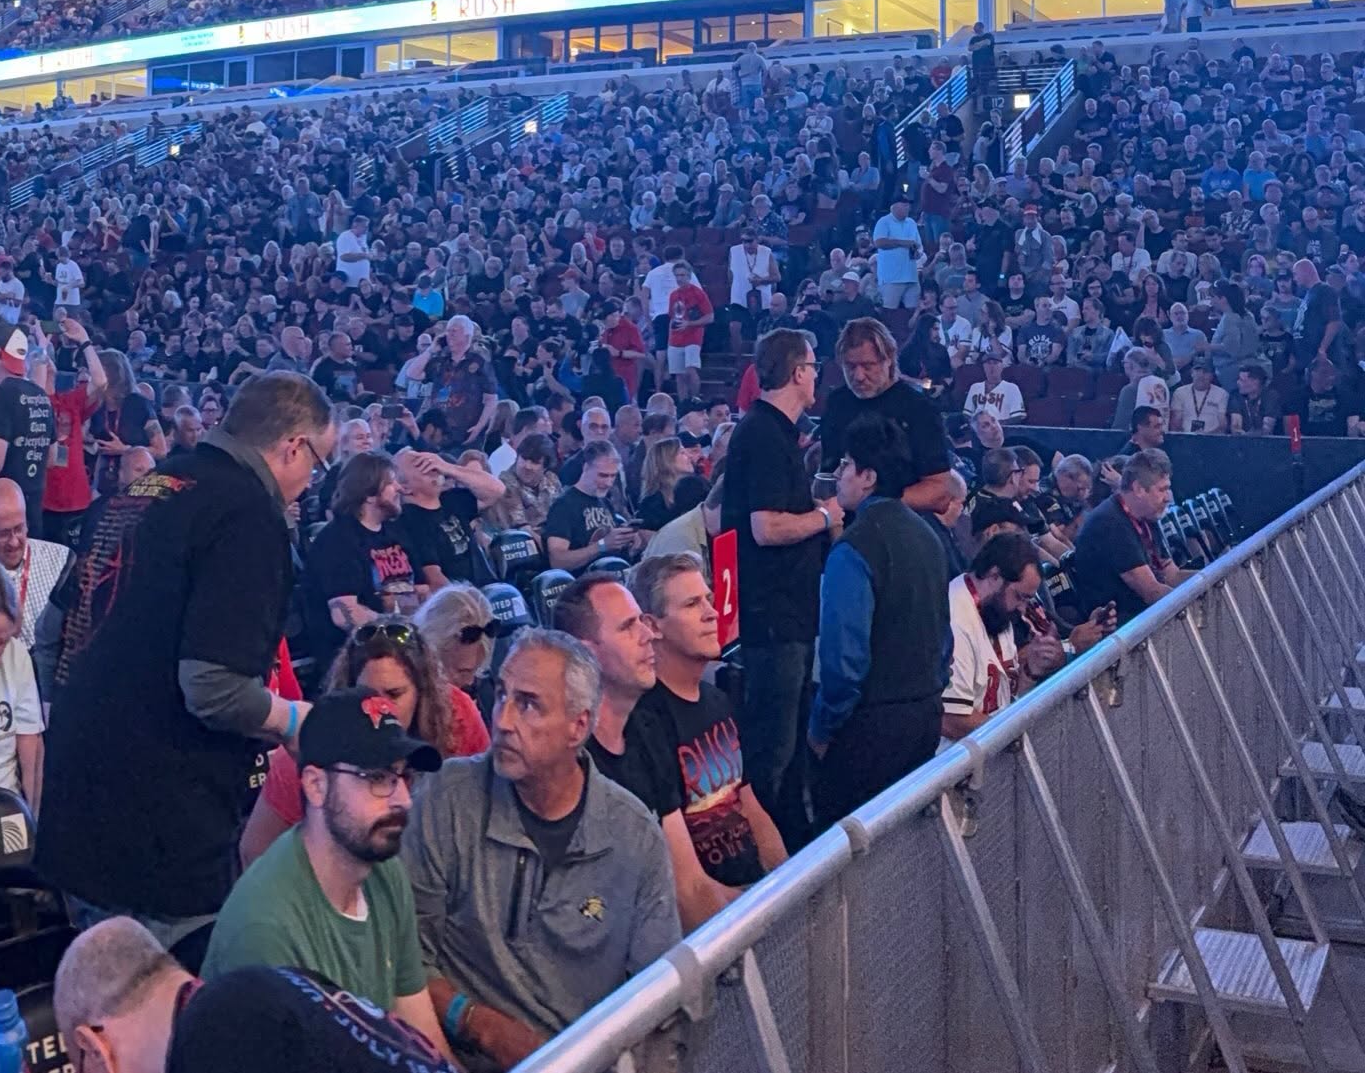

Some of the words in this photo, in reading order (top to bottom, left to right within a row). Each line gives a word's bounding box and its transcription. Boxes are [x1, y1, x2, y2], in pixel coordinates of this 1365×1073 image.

[263, 16, 310, 42] RUSH
[501, 541, 526, 552] UNITED
[504, 551, 528, 560] CENTER
[722, 568, 733, 617] 2
[678, 717, 741, 802] RUSH
